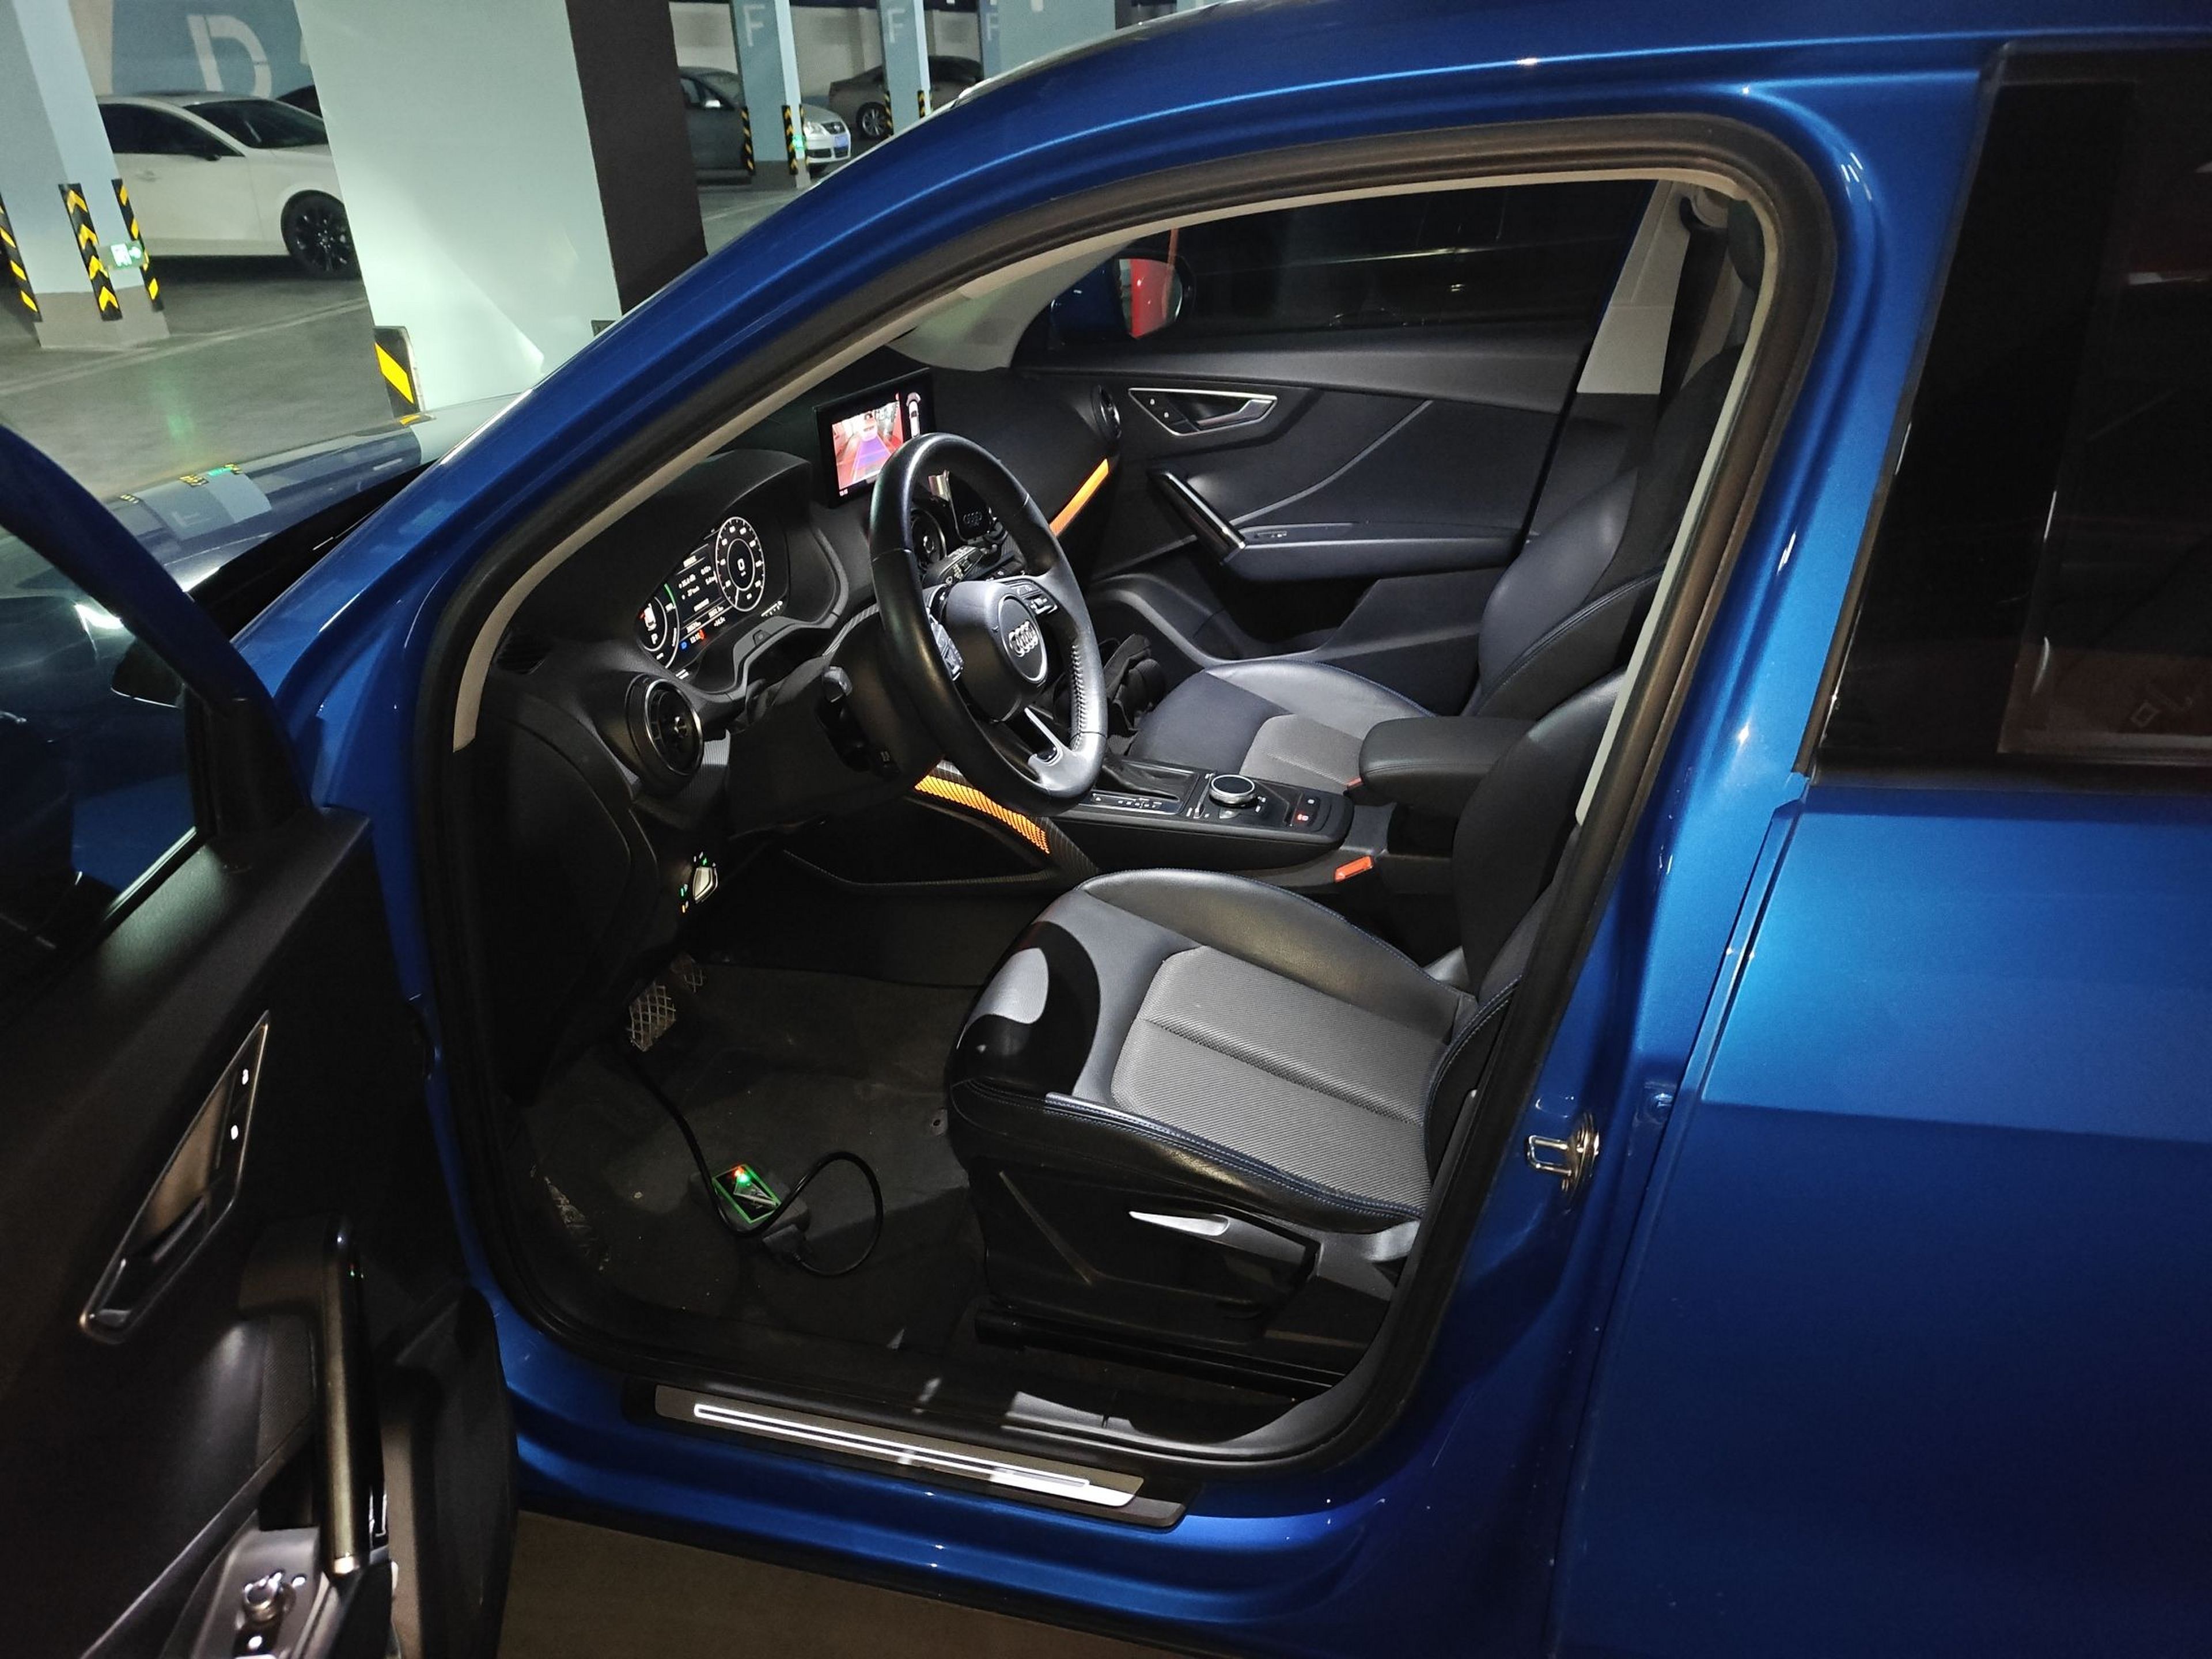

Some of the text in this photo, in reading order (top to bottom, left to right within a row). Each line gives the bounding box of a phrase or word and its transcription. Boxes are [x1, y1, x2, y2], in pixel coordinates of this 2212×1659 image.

[743, 4, 765, 47] F
[887, 8, 906, 43] F
[187, 14, 272, 99] D
